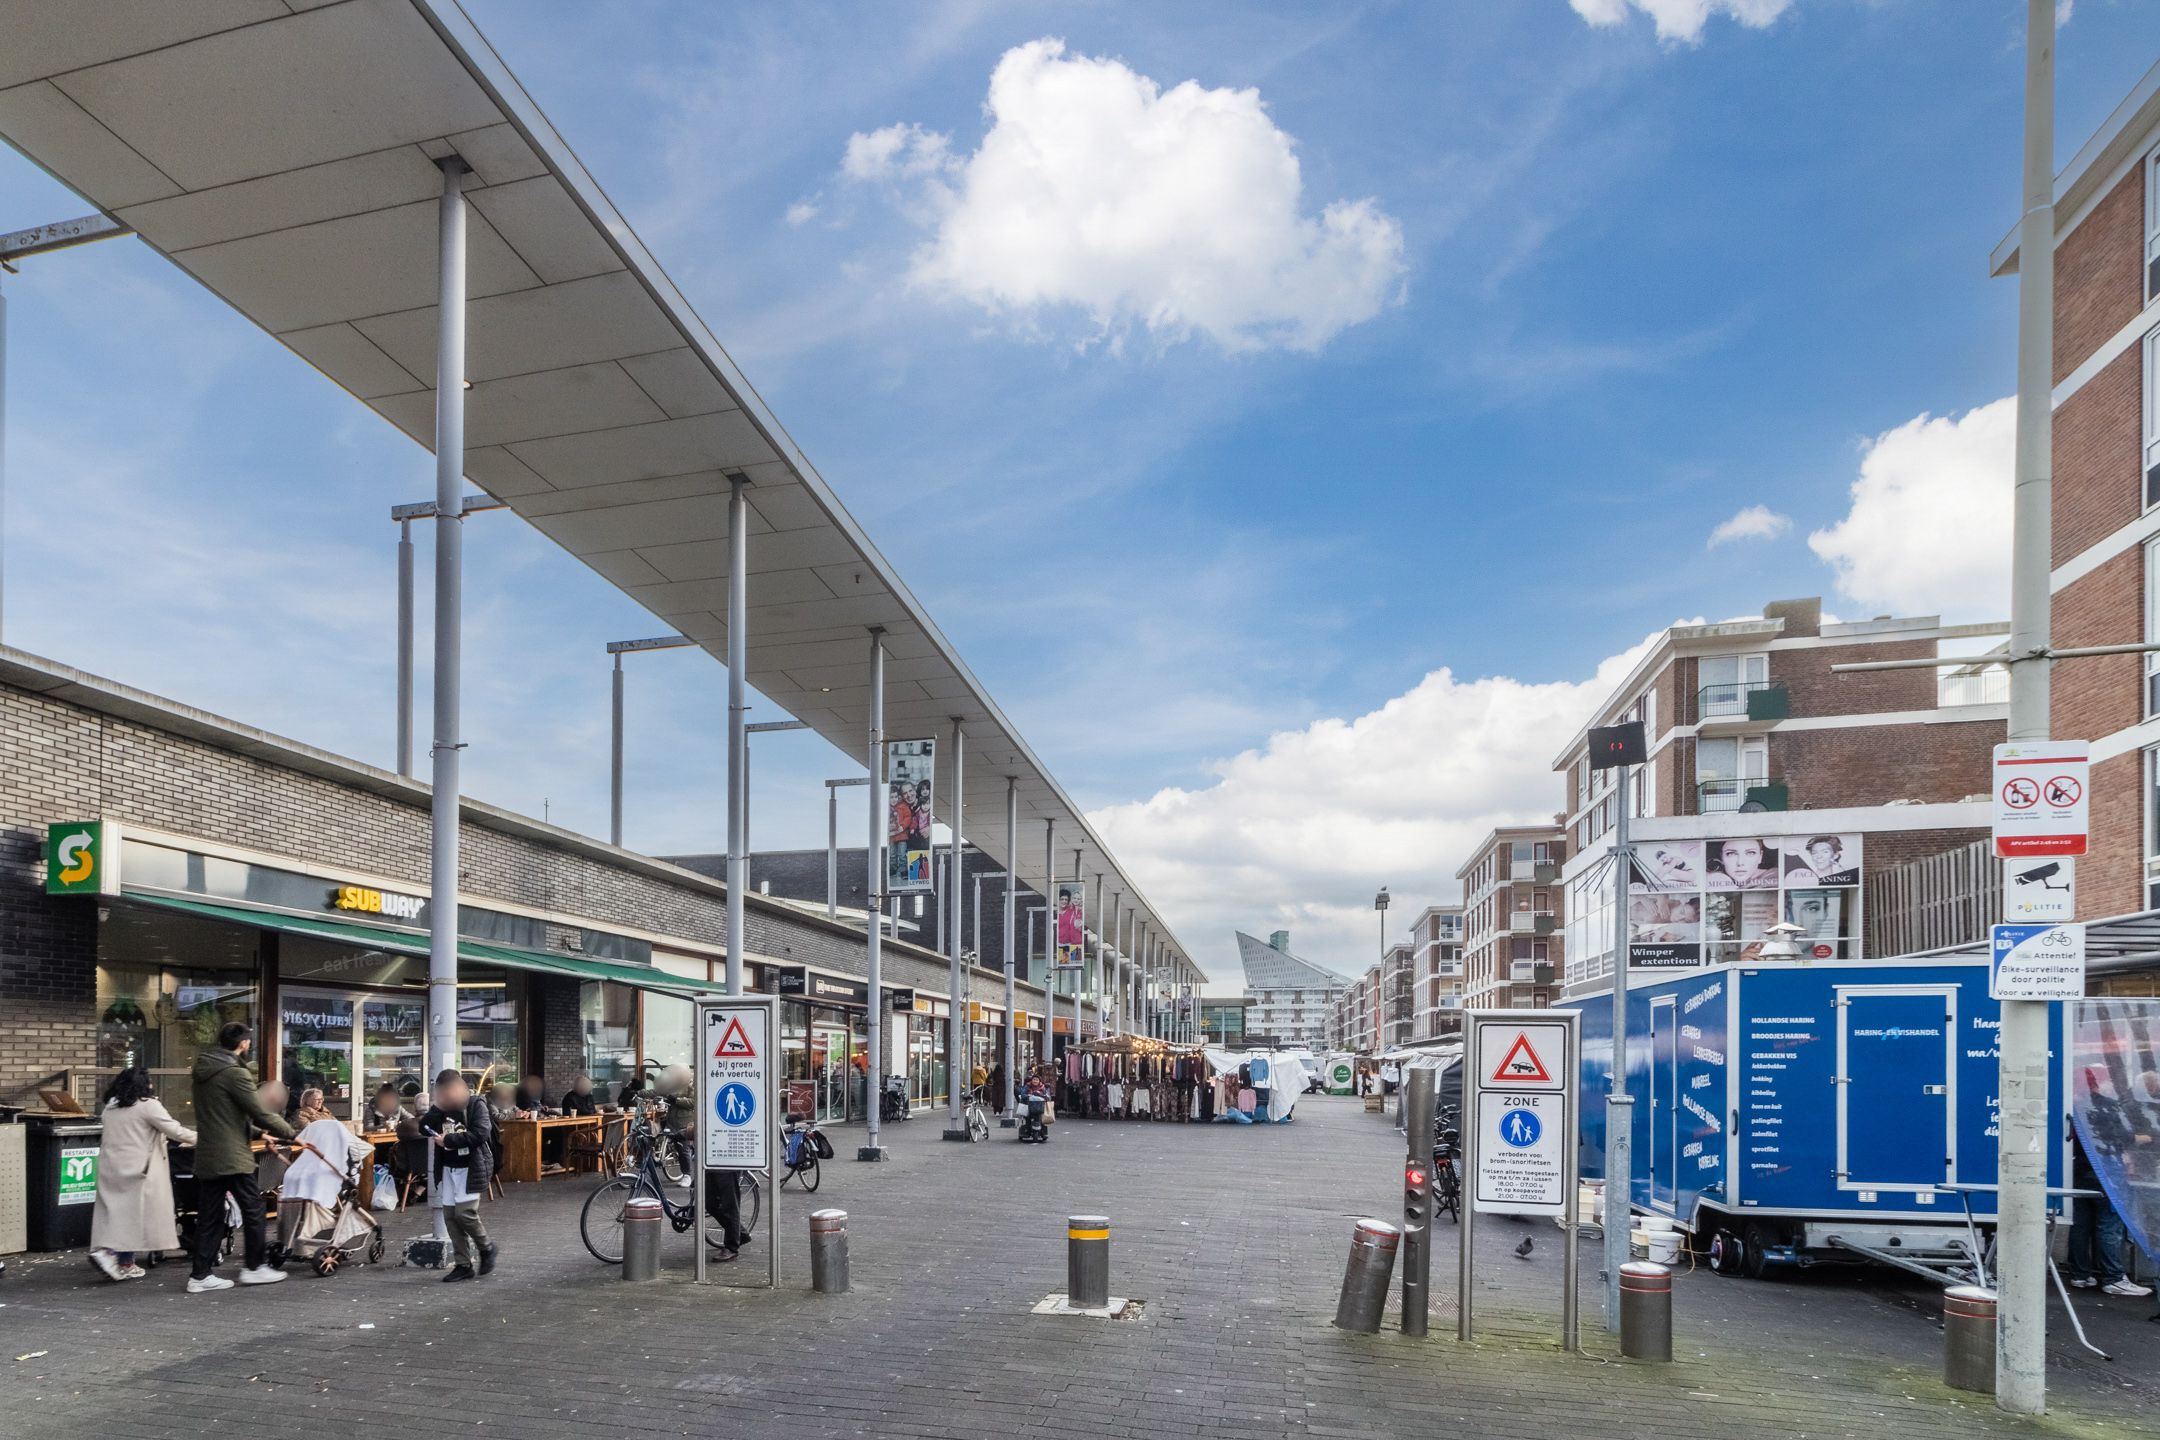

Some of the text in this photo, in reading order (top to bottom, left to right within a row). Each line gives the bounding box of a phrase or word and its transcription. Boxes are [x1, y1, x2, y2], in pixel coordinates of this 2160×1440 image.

[336, 886, 425, 919] SUBWAY
[2018, 902, 2062, 912] POLITIE
[1632, 948, 1674, 959] Wimper
[1641, 957, 1698, 966] extentions
[718, 1061, 752, 1070] bij groen
[710, 1070, 761, 1080] één voertuig
[1504, 1097, 1539, 1107] ZONE
